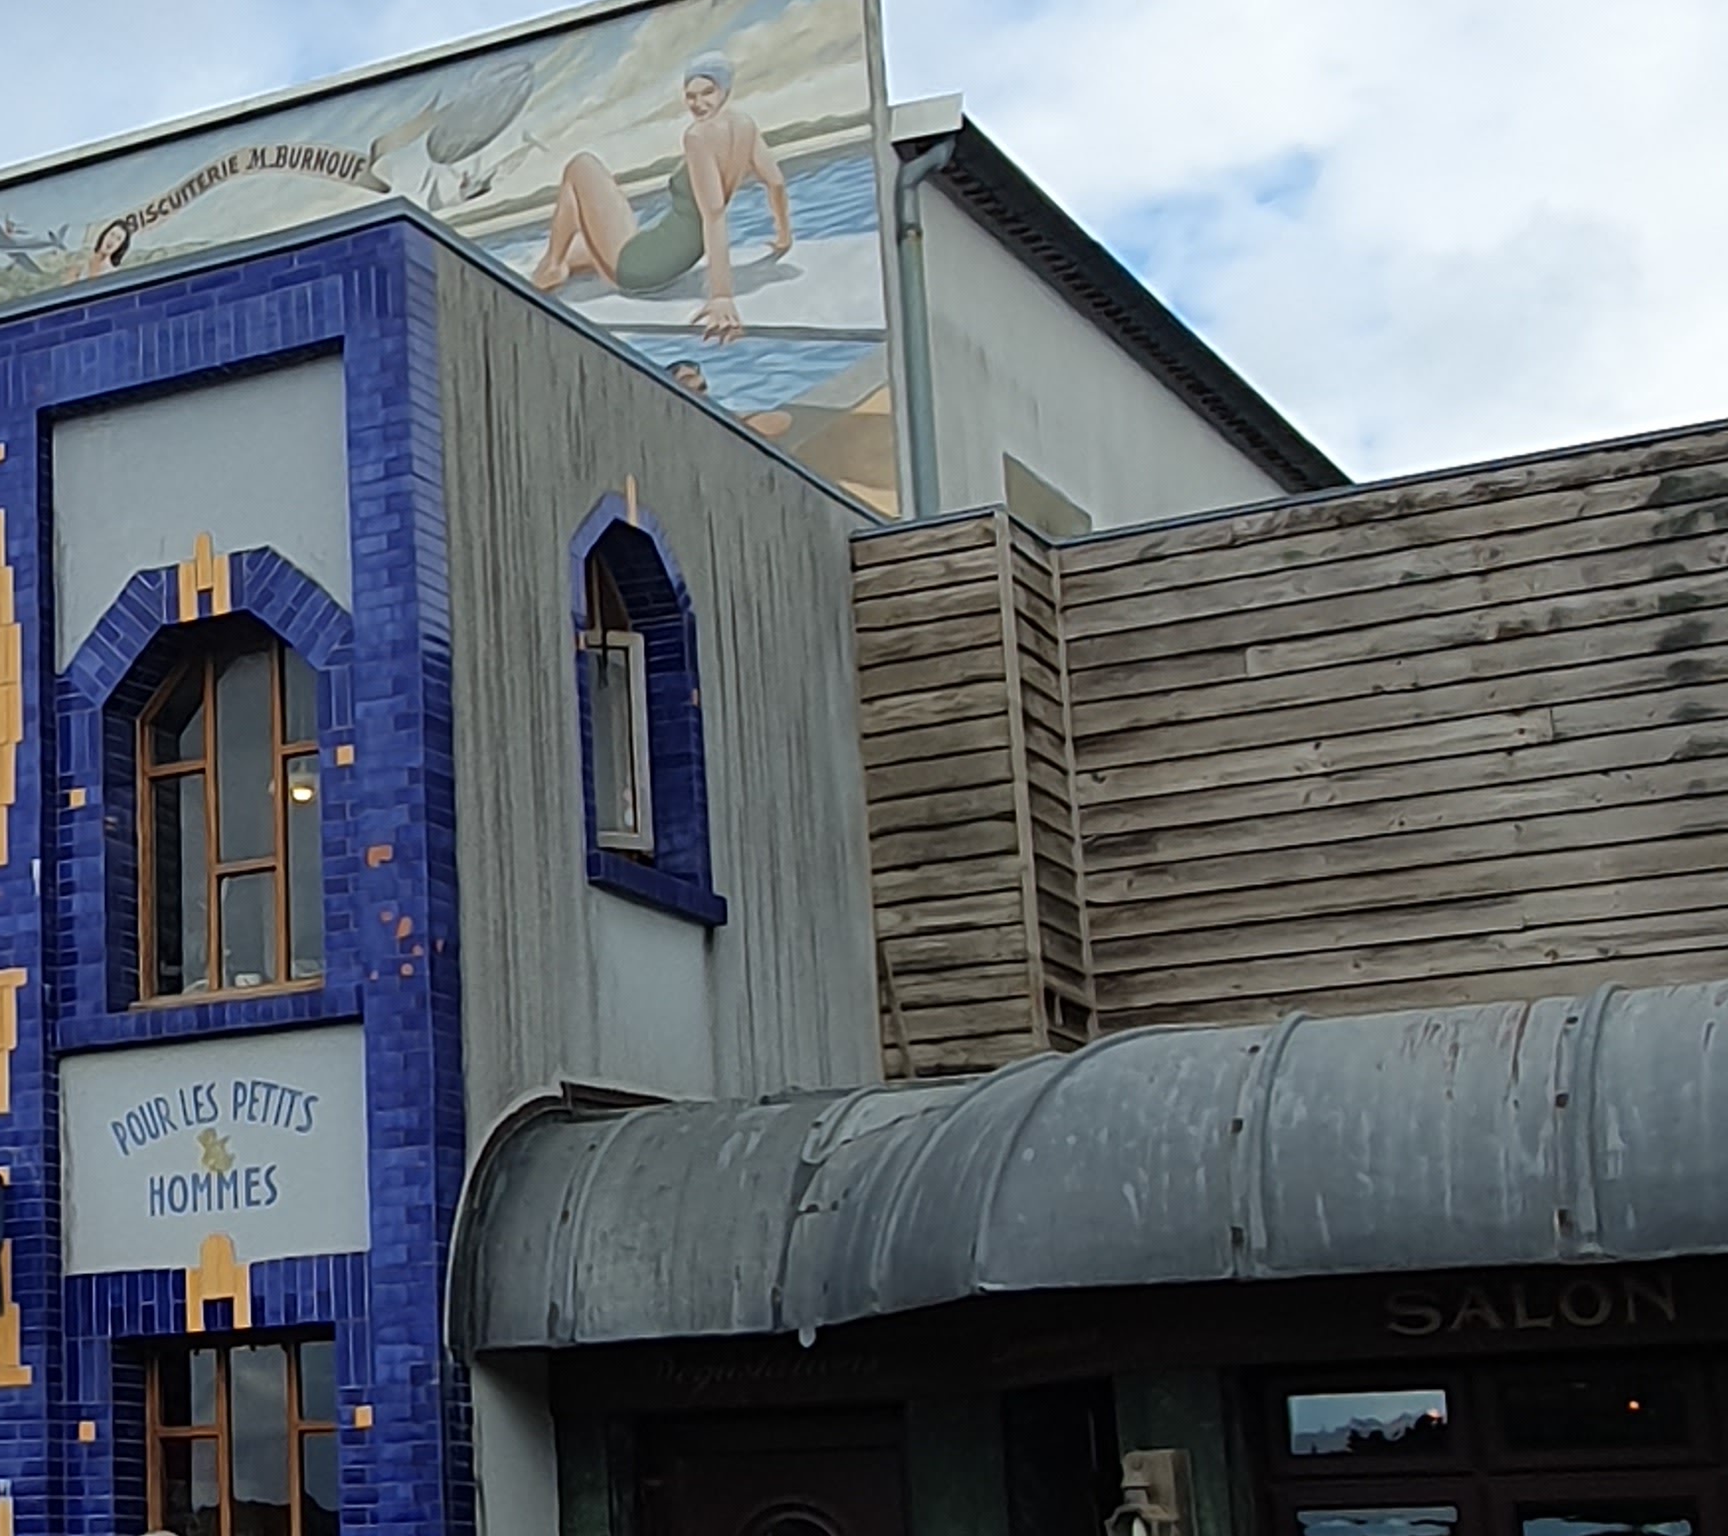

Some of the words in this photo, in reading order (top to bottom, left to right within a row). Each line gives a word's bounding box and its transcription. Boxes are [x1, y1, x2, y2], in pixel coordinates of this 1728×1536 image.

[125, 156, 240, 232] BISCUITERIE
[111, 1096, 177, 1156] POUR
[179, 1082, 219, 1126] LES
[232, 1080, 319, 1134] PETITS
[149, 1164, 278, 1216] HOMMES
[1383, 1270, 1679, 1338] SALON
